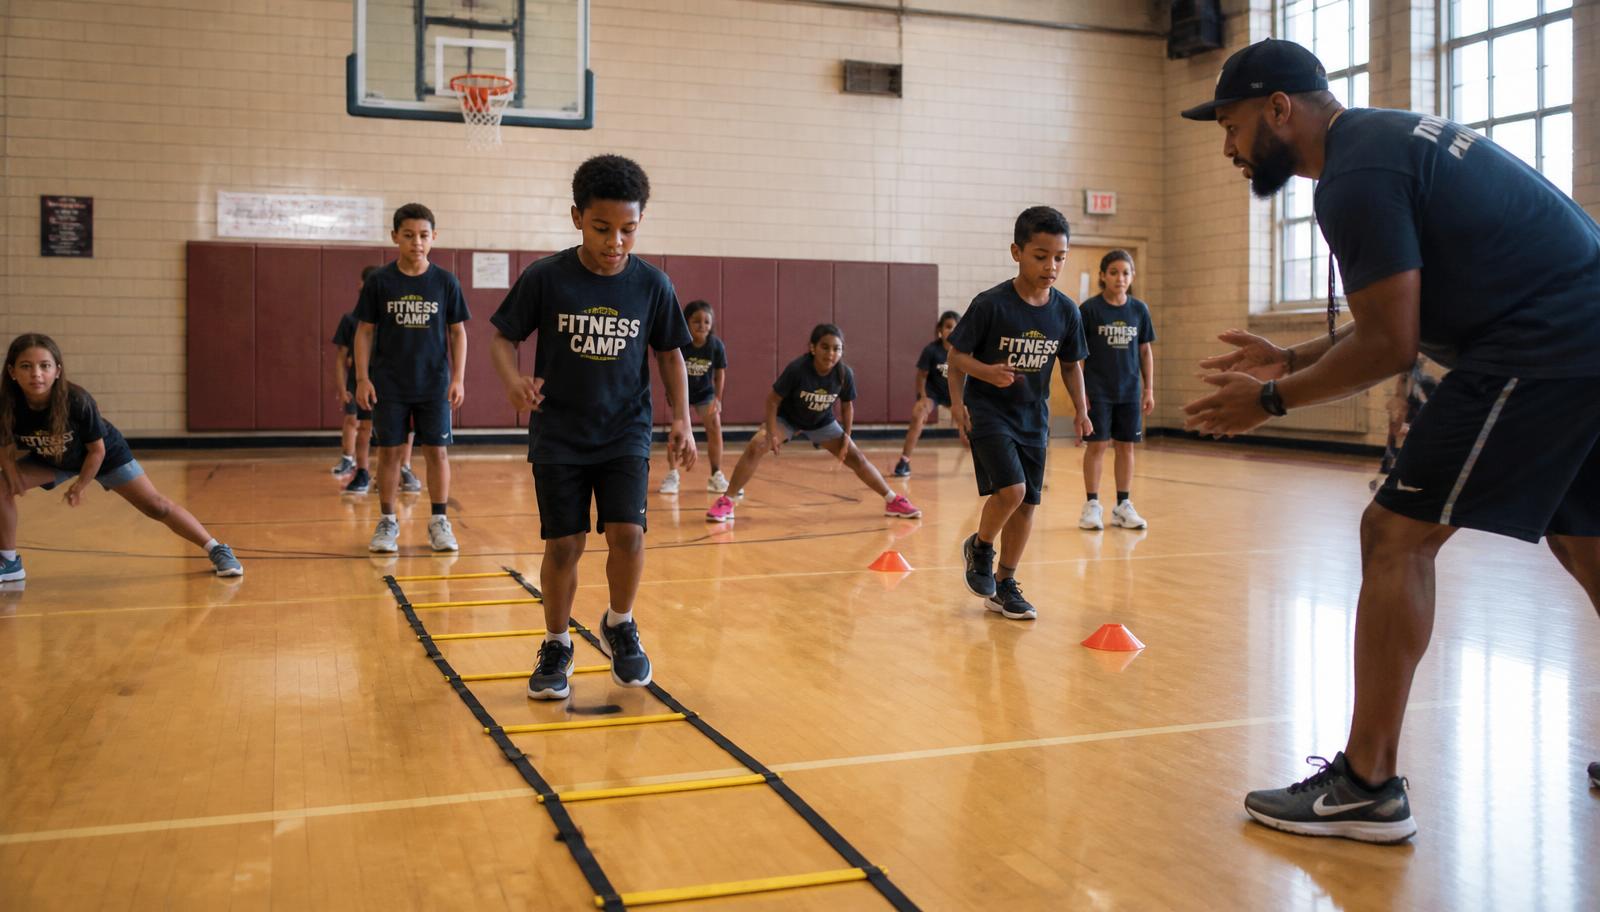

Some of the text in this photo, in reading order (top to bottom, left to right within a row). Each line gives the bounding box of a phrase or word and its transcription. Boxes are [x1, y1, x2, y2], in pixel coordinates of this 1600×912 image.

[387, 301, 439, 314] FITNESS
[395, 312, 431, 325] CAMP
[558, 313, 641, 338] FITNESS
[570, 334, 627, 356] CAMP
[999, 336, 1059, 355] FITNESS
[1007, 352, 1049, 369] CAMP
